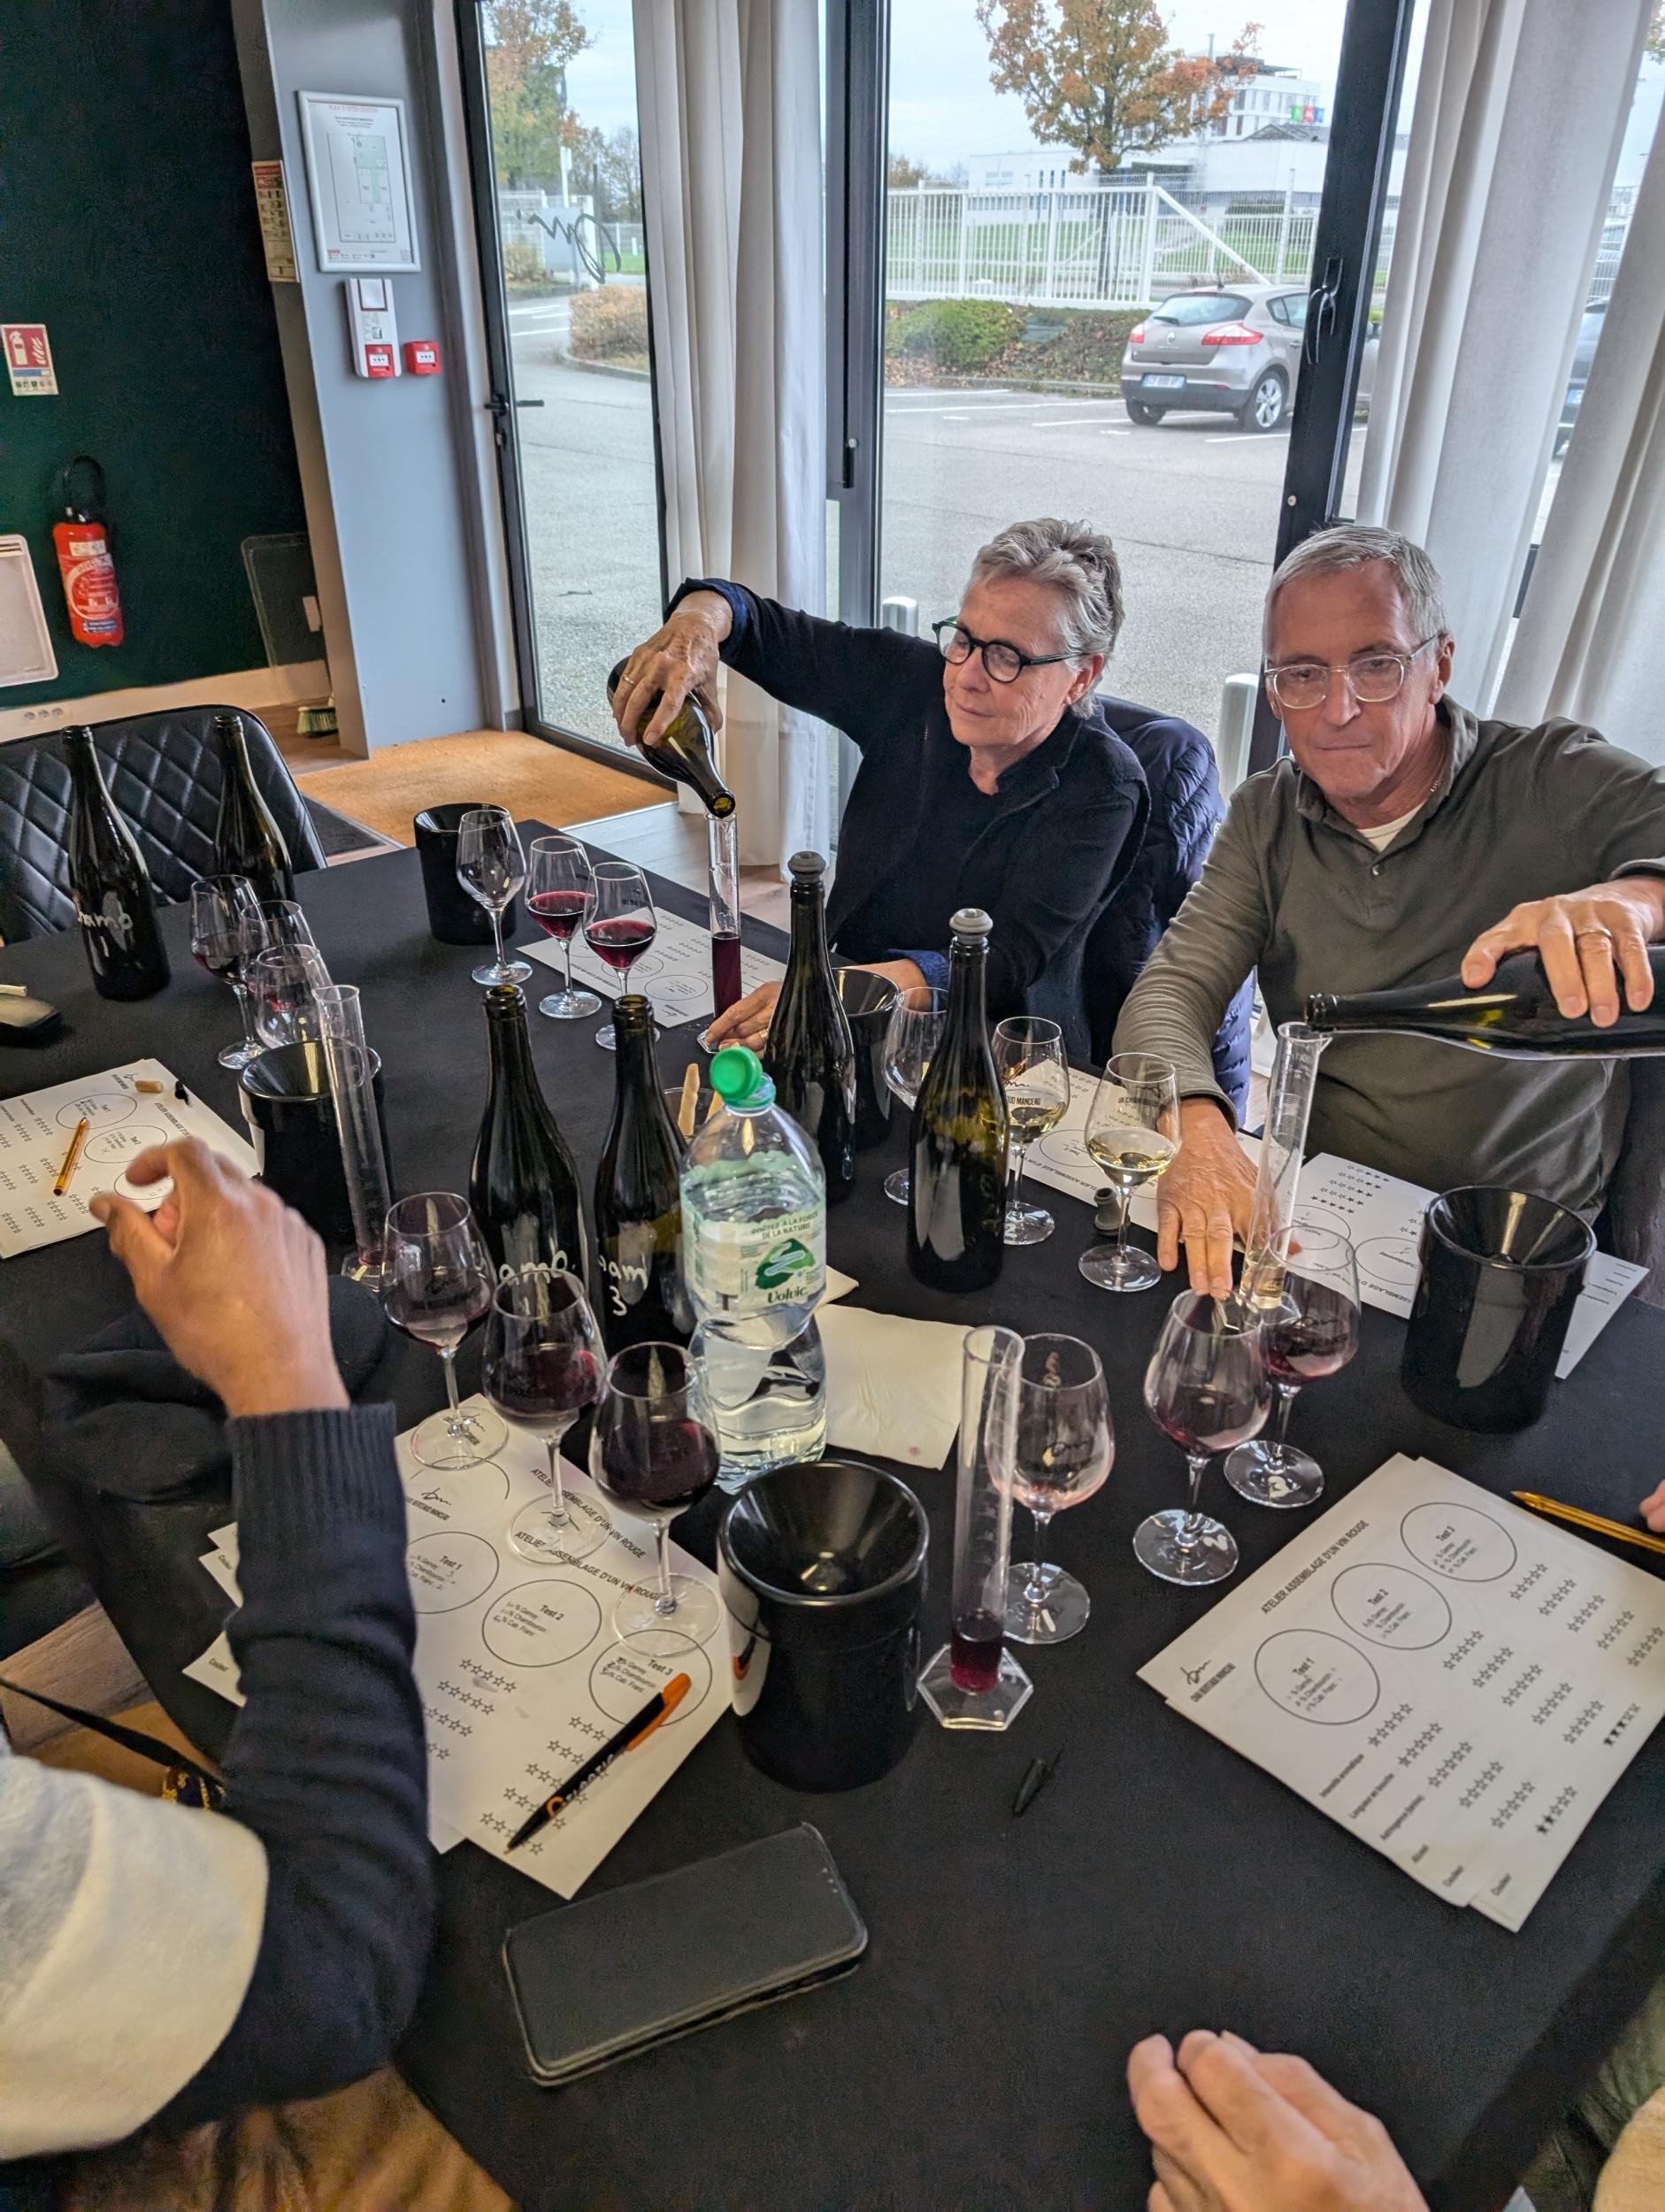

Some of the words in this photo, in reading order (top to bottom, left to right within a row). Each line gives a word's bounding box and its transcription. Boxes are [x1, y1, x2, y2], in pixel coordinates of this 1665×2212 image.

[768, 1286, 806, 1303] Volvic
[531, 1468, 554, 1487] ATELIE
[561, 1490, 598, 1517] SSEMBLAGE
[621, 1536, 646, 1559] ROUGE
[1436, 1528, 1452, 1543] Test
[440, 1555, 457, 1569] Test
[1261, 1587, 1288, 1615] ATELIER
[1285, 1554, 1327, 1594] ASSEMBLAGE
[1324, 1543, 1340, 1561] D'UN
[1336, 1533, 1349, 1550] VIN
[1346, 1519, 1370, 1541] ROUGE
[599, 1572, 621, 1587] D'UN
[633, 1586, 661, 1601] ROUG
[1368, 1592, 1384, 1607] Test
[540, 1604, 558, 1618] Test
[556, 1612, 564, 1621] 2
[648, 1658, 666, 1673] Test
[665, 1667, 673, 1676] 3
[1292, 1661, 1309, 1676] Test
